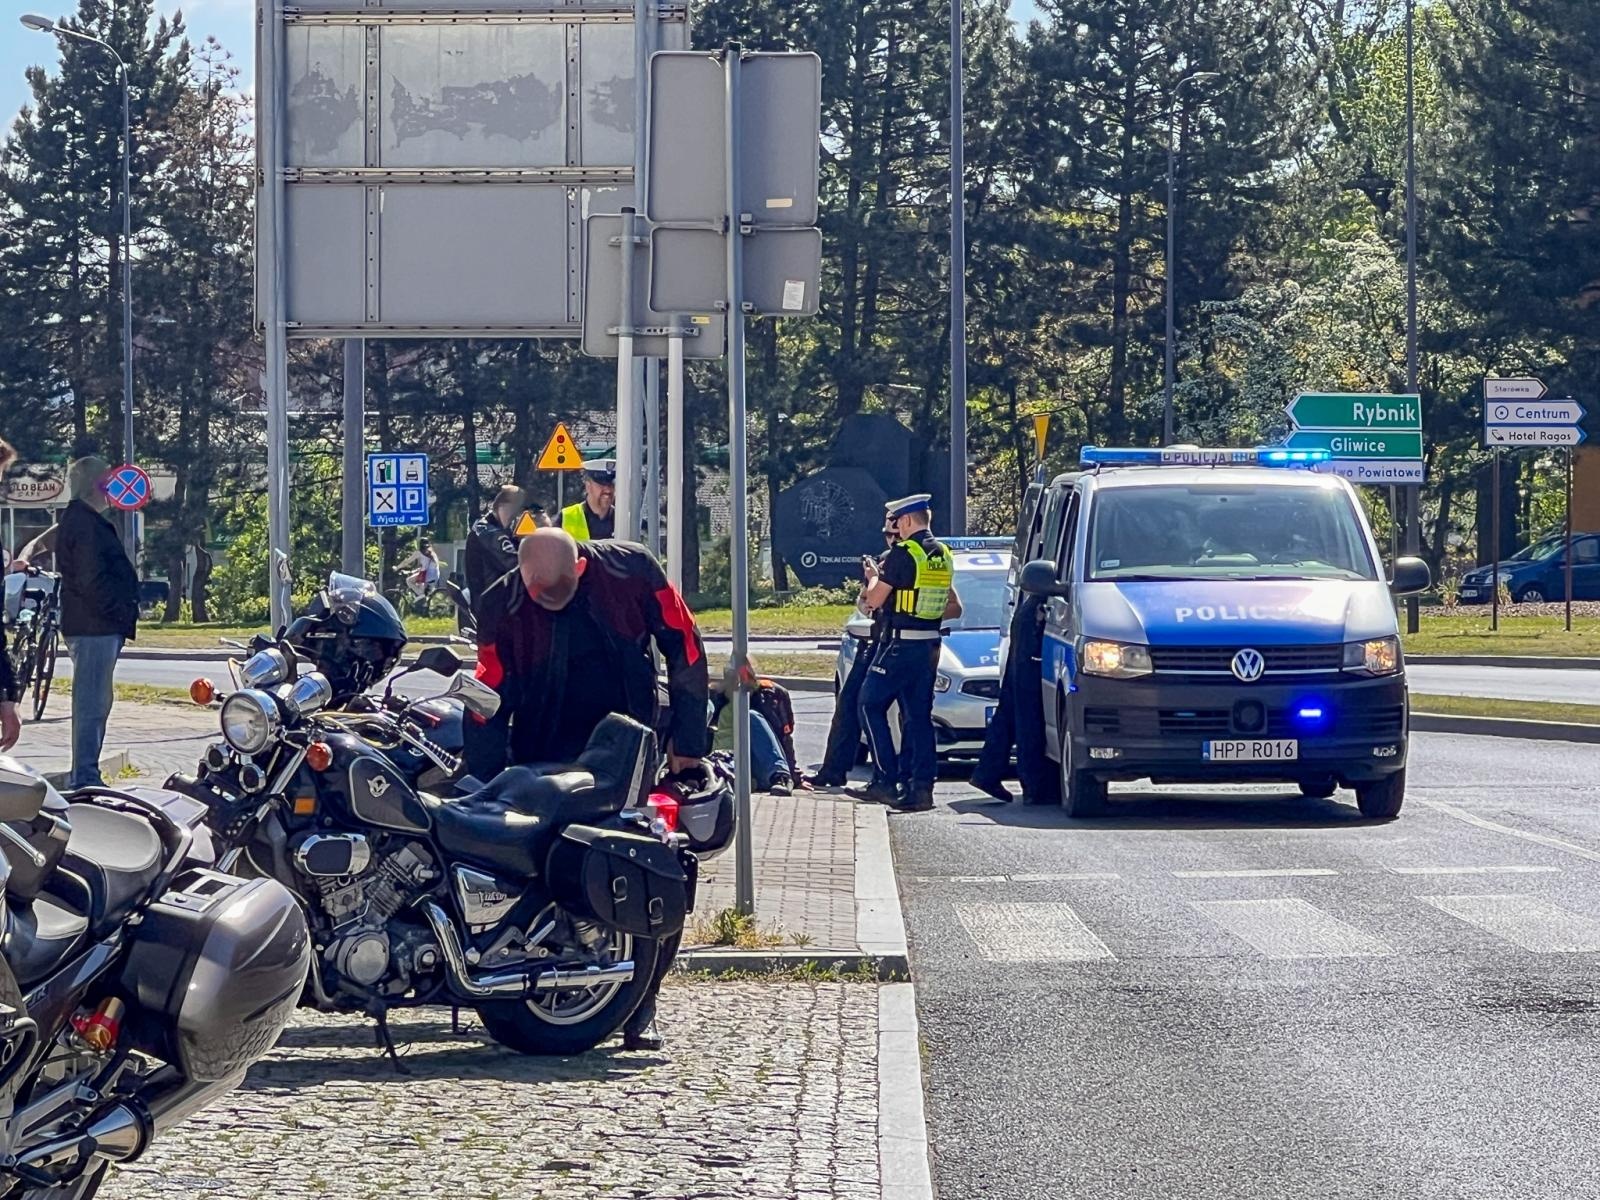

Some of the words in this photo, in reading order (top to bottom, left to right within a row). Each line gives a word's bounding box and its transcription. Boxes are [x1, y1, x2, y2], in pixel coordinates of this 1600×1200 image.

[1353, 402, 1416, 427] Rybnik
[1515, 407, 1570, 419] Centrum
[1509, 431, 1536, 441] Hotel
[1330, 437, 1386, 453] Gliwice
[1174, 452, 1226, 463] POLICJA
[1358, 466, 1421, 478] Powiatowe
[31, 483, 56, 491] BEAN
[377, 515, 405, 524] Wjazd
[1213, 742, 1246, 758] HPP
[1252, 742, 1294, 758] R016
